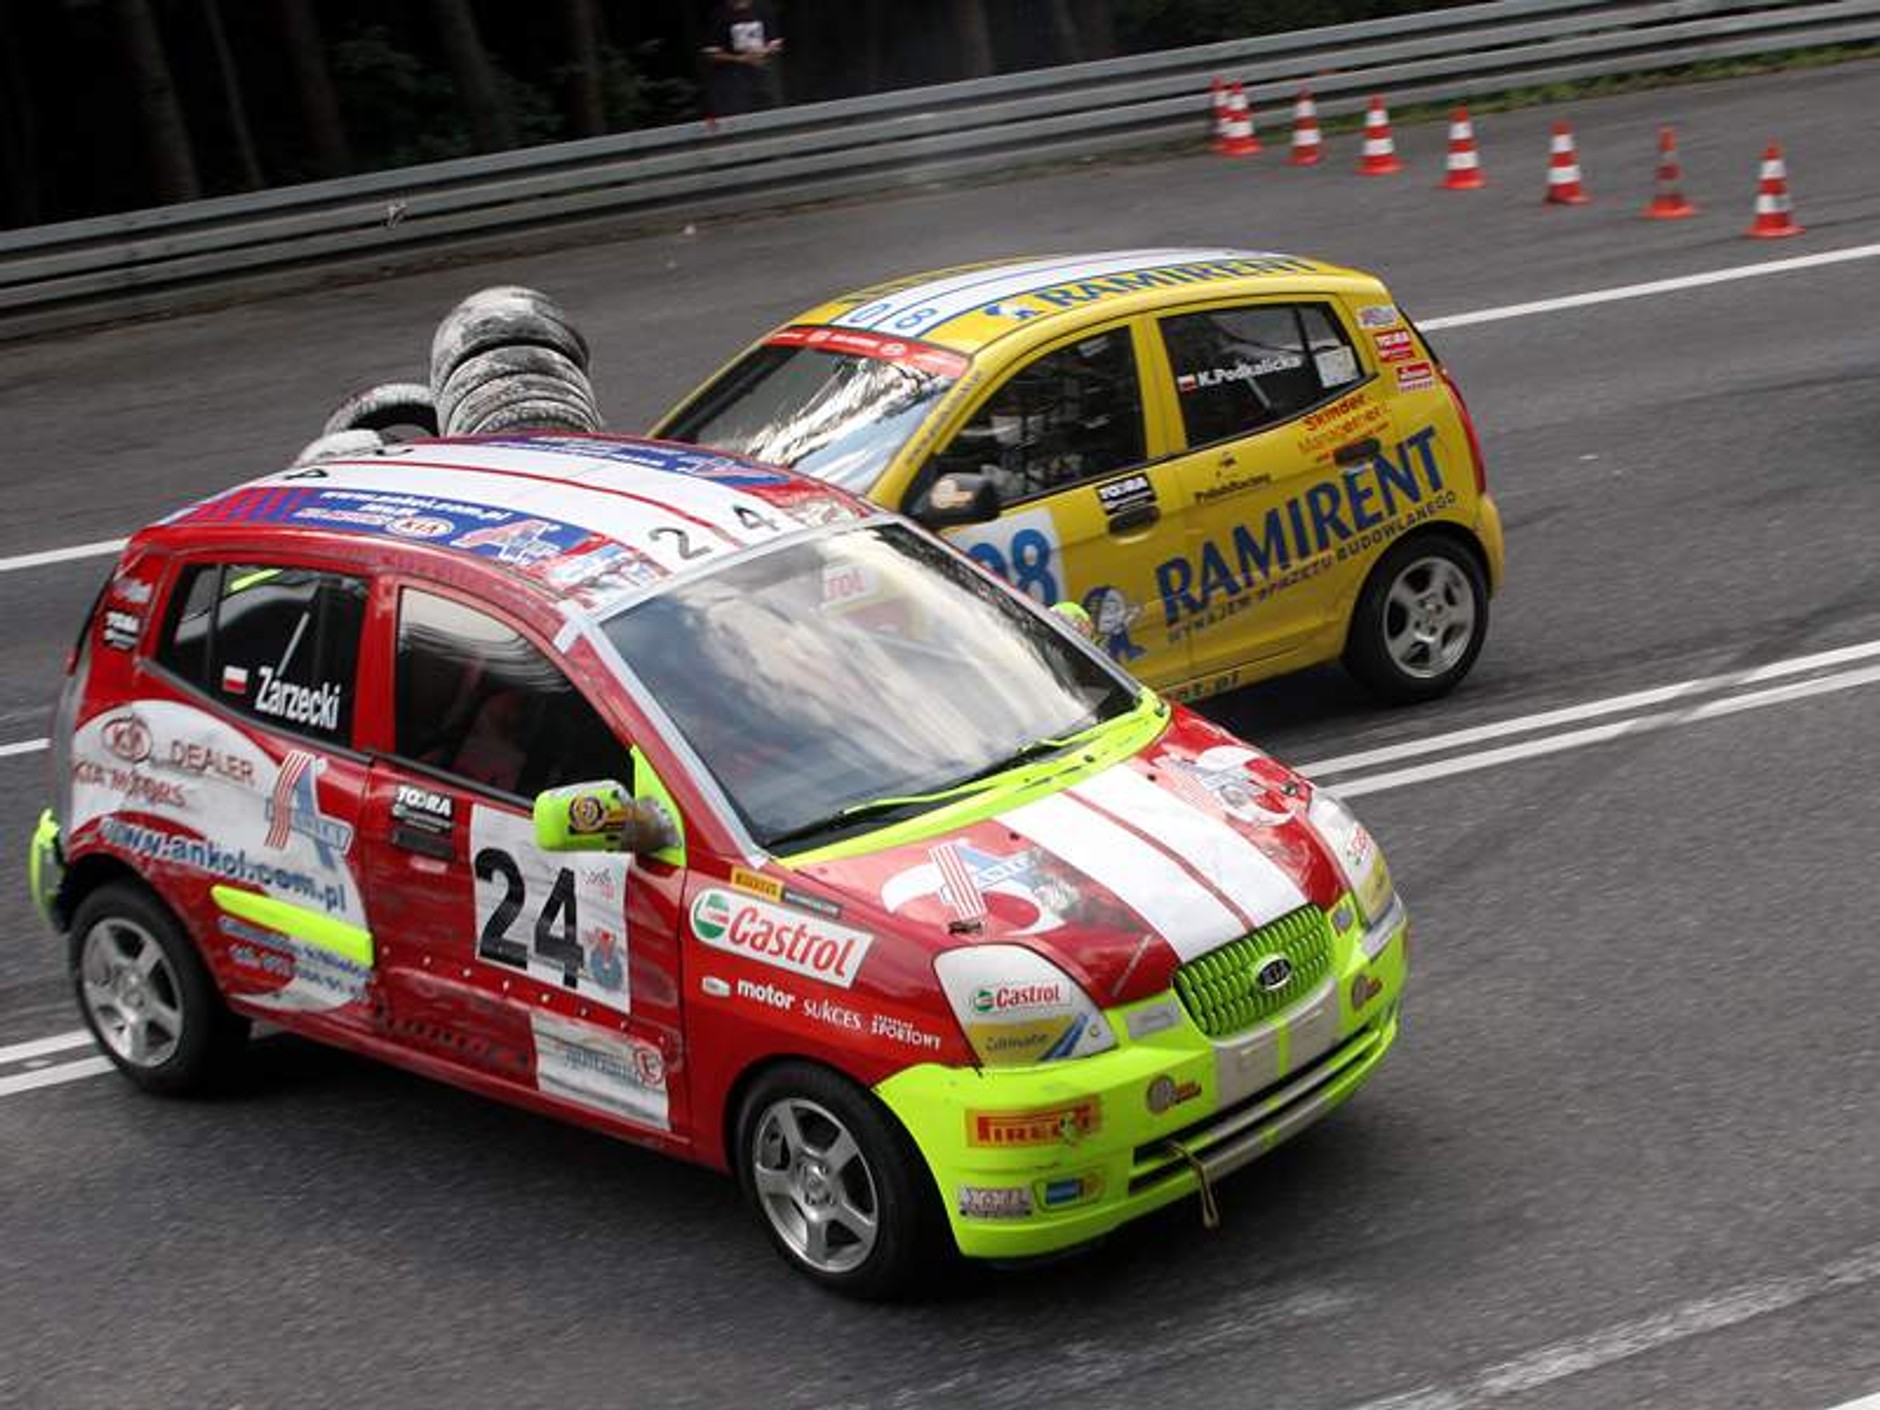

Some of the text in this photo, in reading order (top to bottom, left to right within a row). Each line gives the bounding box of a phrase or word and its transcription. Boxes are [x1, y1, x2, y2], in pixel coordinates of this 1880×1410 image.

[1038, 257, 1317, 309] RAMIRENT
[1156, 426, 1443, 627] RAMIRENT
[255, 667, 341, 730] Zarzecki
[170, 740, 256, 786] DEALER
[474, 847, 586, 989] 24
[728, 906, 856, 978] Castrol
[737, 978, 796, 1011] motor
[996, 983, 1062, 1008] Castrol
